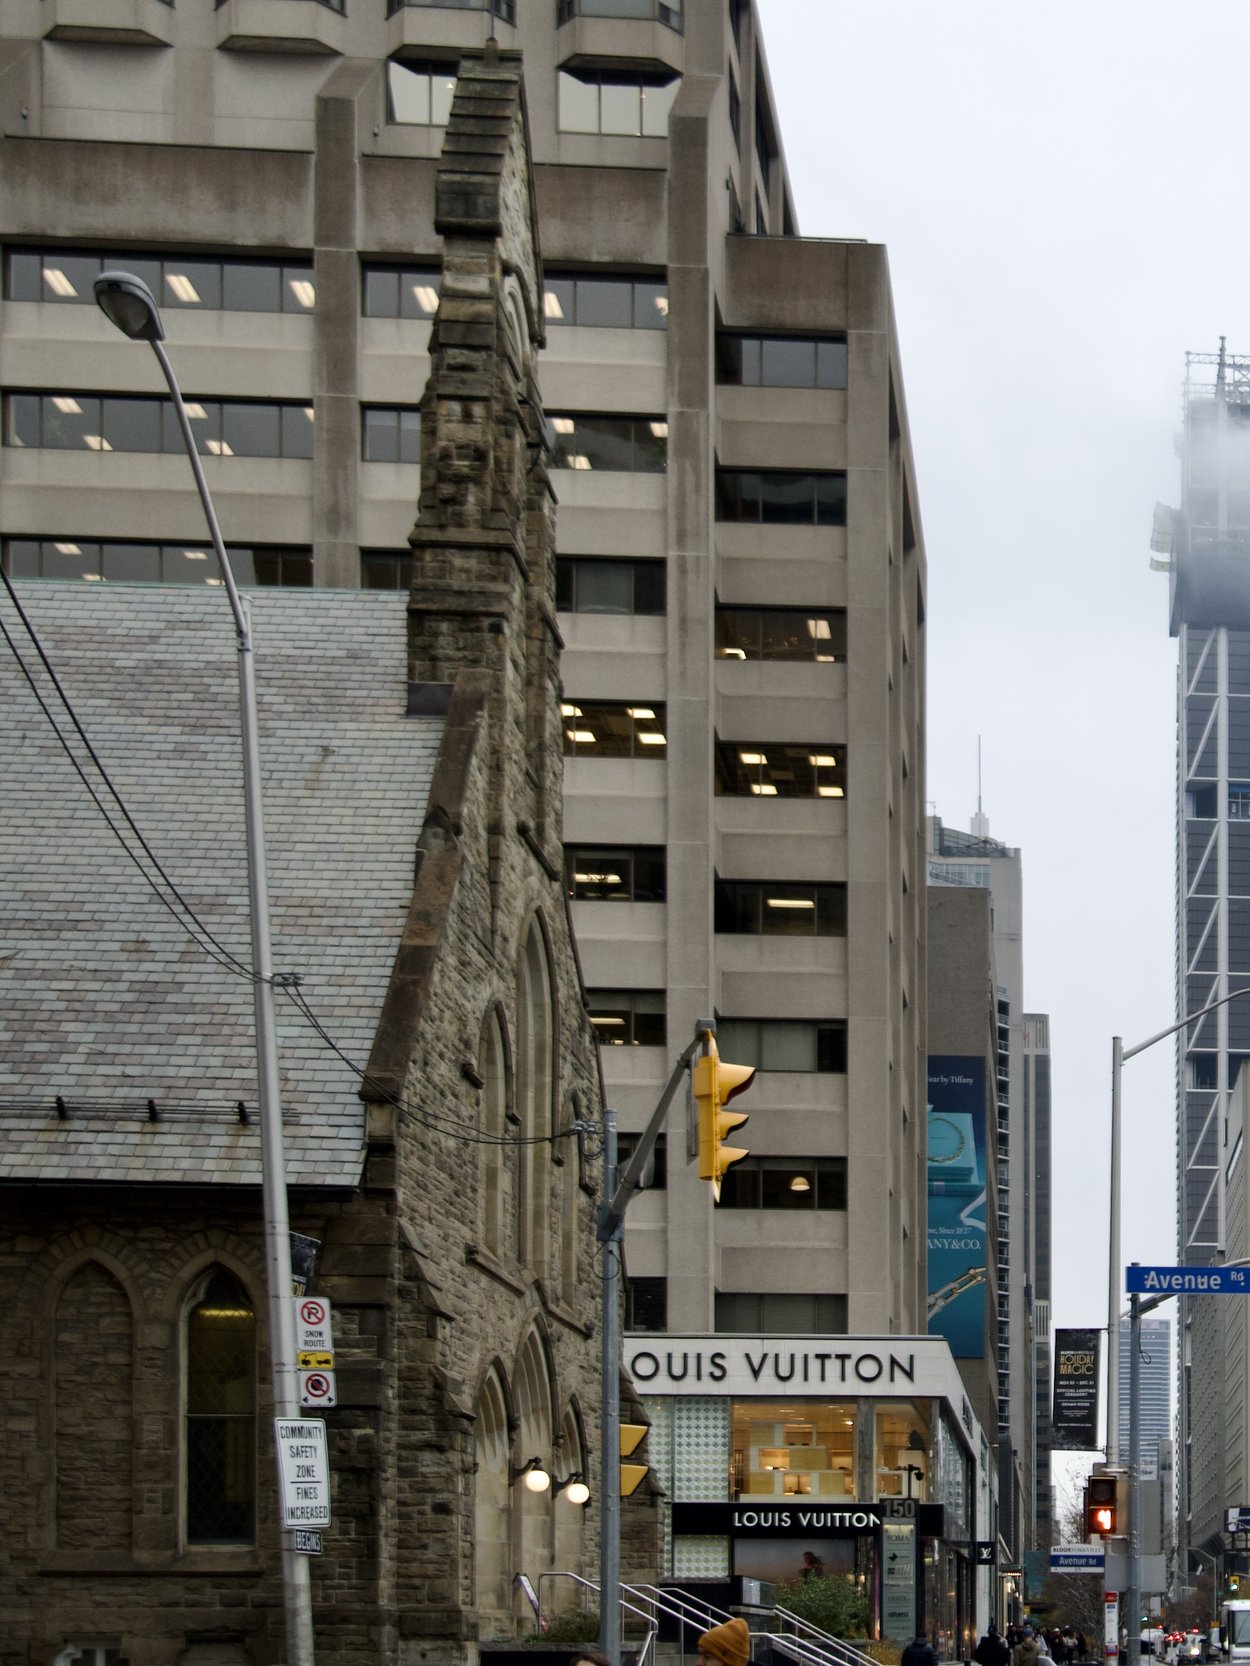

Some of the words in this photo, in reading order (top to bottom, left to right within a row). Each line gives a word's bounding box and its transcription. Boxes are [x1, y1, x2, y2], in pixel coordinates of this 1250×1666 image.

[1145, 1270, 1222, 1290] Avenue
[1230, 1271, 1244, 1282] Rd
[304, 1330, 324, 1338] SNOW
[304, 1339, 326, 1348] ROUTE
[1060, 1354, 1095, 1364] HOLIDAY
[631, 1351, 728, 1382] OUIS
[745, 1352, 915, 1383] VUITTON
[1060, 1363, 1094, 1375] MAGIC
[280, 1426, 323, 1440] COMMUNITY
[290, 1445, 318, 1459] SAFETY
[296, 1465, 316, 1478] ZONE
[296, 1487, 319, 1501] FINES
[287, 1505, 328, 1520] INCREASED
[883, 1500, 916, 1518] 150
[735, 1512, 791, 1528] LOUIS
[796, 1512, 881, 1528] VUITTON
[296, 1531, 321, 1550] BEGINS
[1059, 1556, 1087, 1566] Avenue
[1088, 1557, 1098, 1566] Rd
